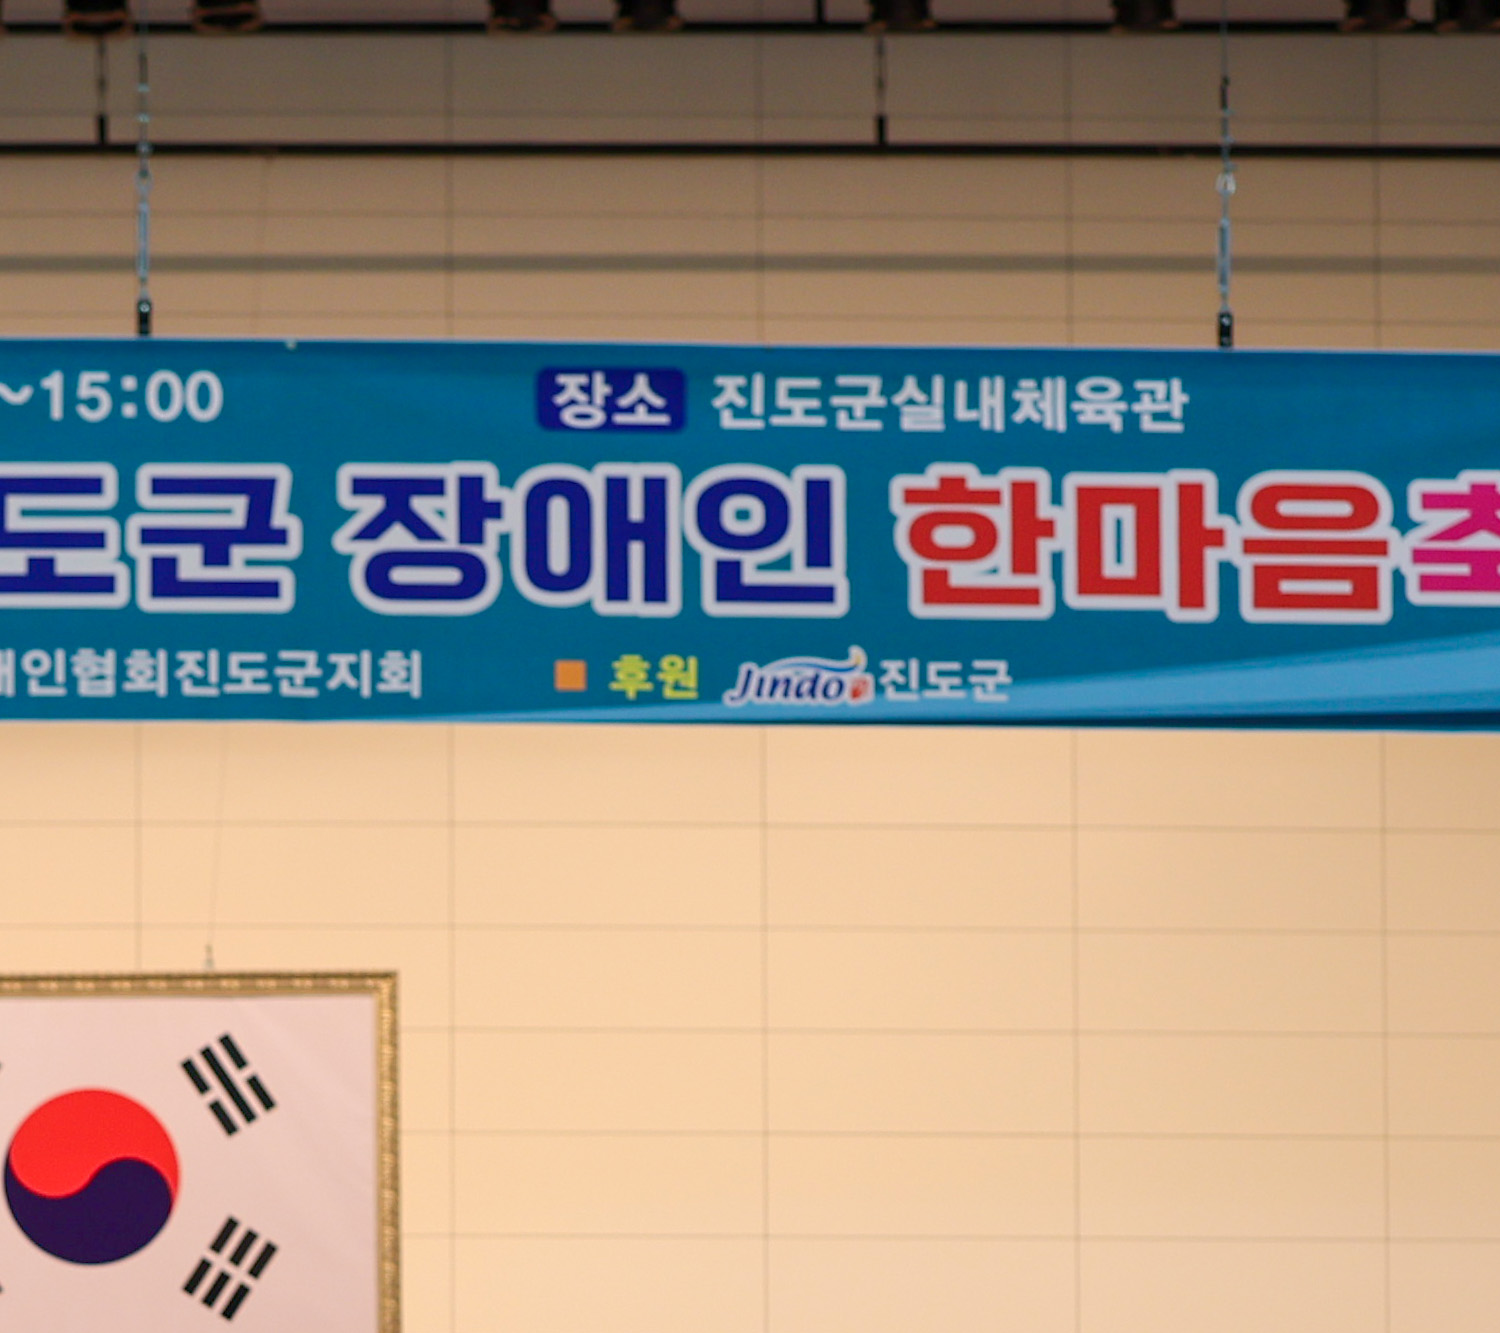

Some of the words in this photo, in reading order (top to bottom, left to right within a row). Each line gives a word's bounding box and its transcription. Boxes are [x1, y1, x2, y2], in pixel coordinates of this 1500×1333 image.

[553, 373, 671, 428] 장소
[710, 373, 1190, 434] 진도군실내체육관
[344, 470, 838, 606] 장애인
[610, 653, 700, 700] 후원
[879, 659, 1013, 702] 진도군
